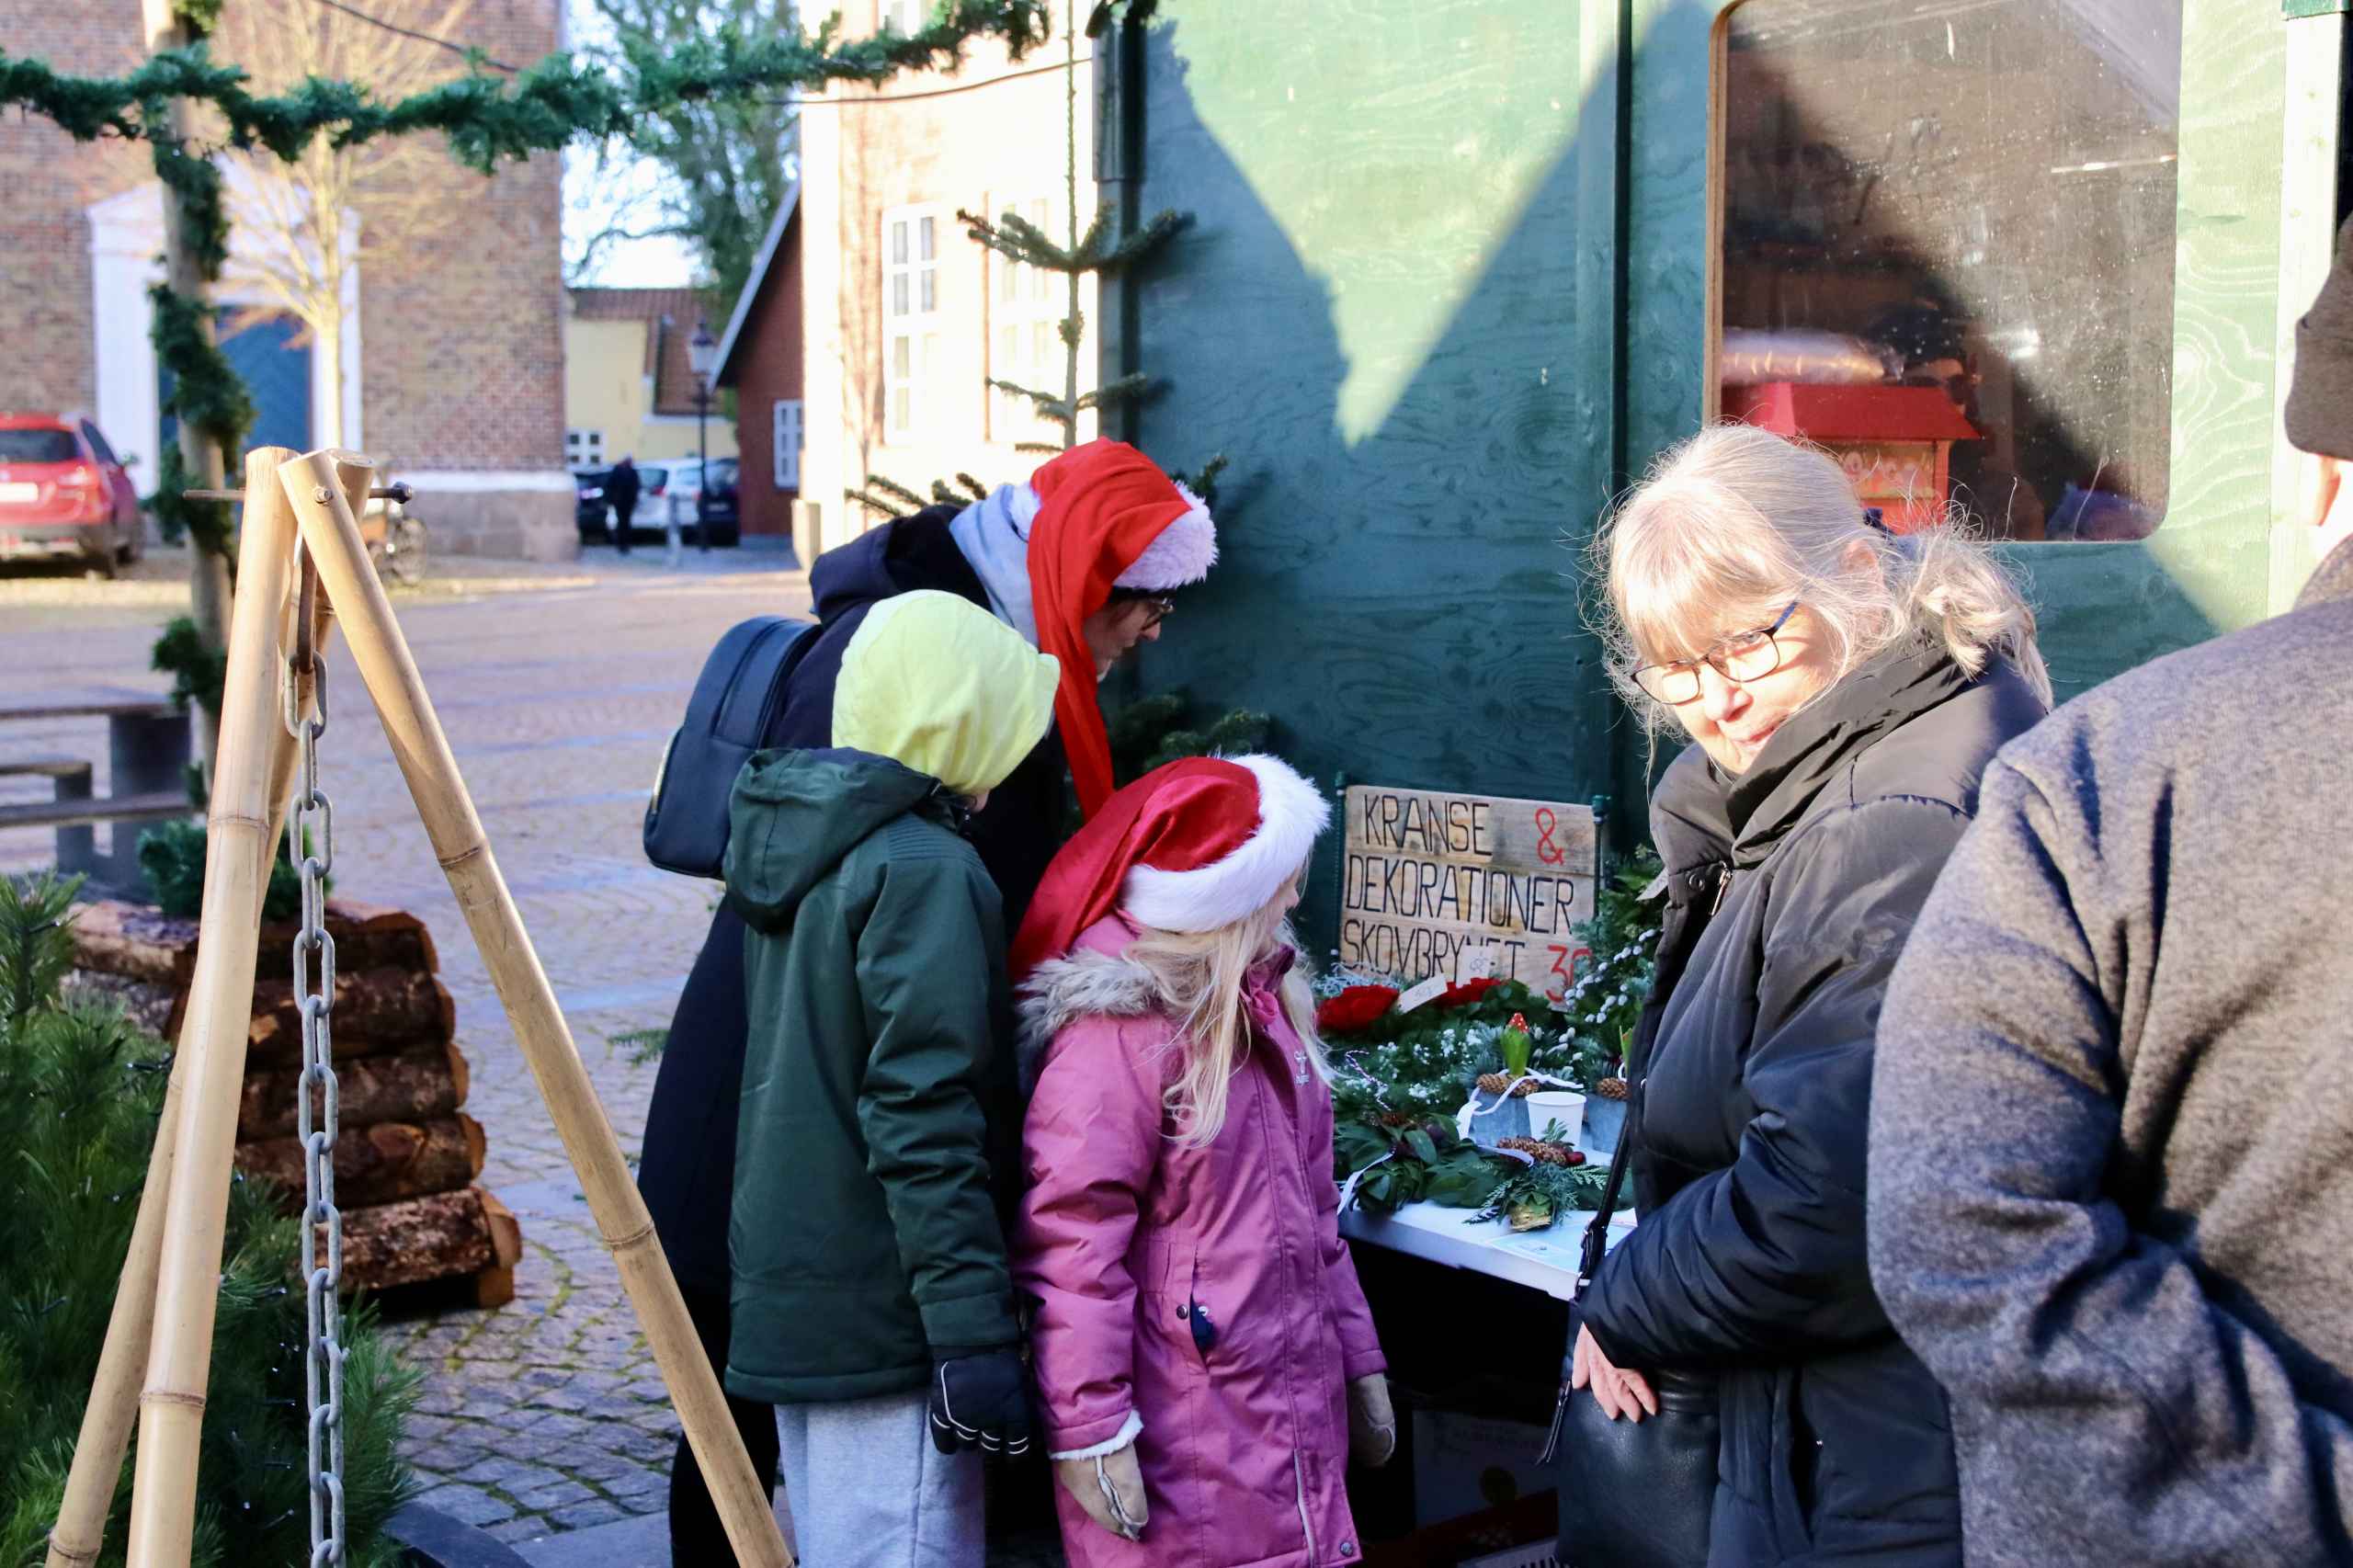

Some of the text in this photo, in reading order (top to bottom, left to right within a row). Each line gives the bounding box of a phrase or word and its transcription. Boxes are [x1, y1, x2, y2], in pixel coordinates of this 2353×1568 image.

[1364, 793, 1565, 865] KRANSE &
[1346, 855, 1574, 935] DEKORATIONER
[1344, 919, 1526, 983] SKOVBRYT
